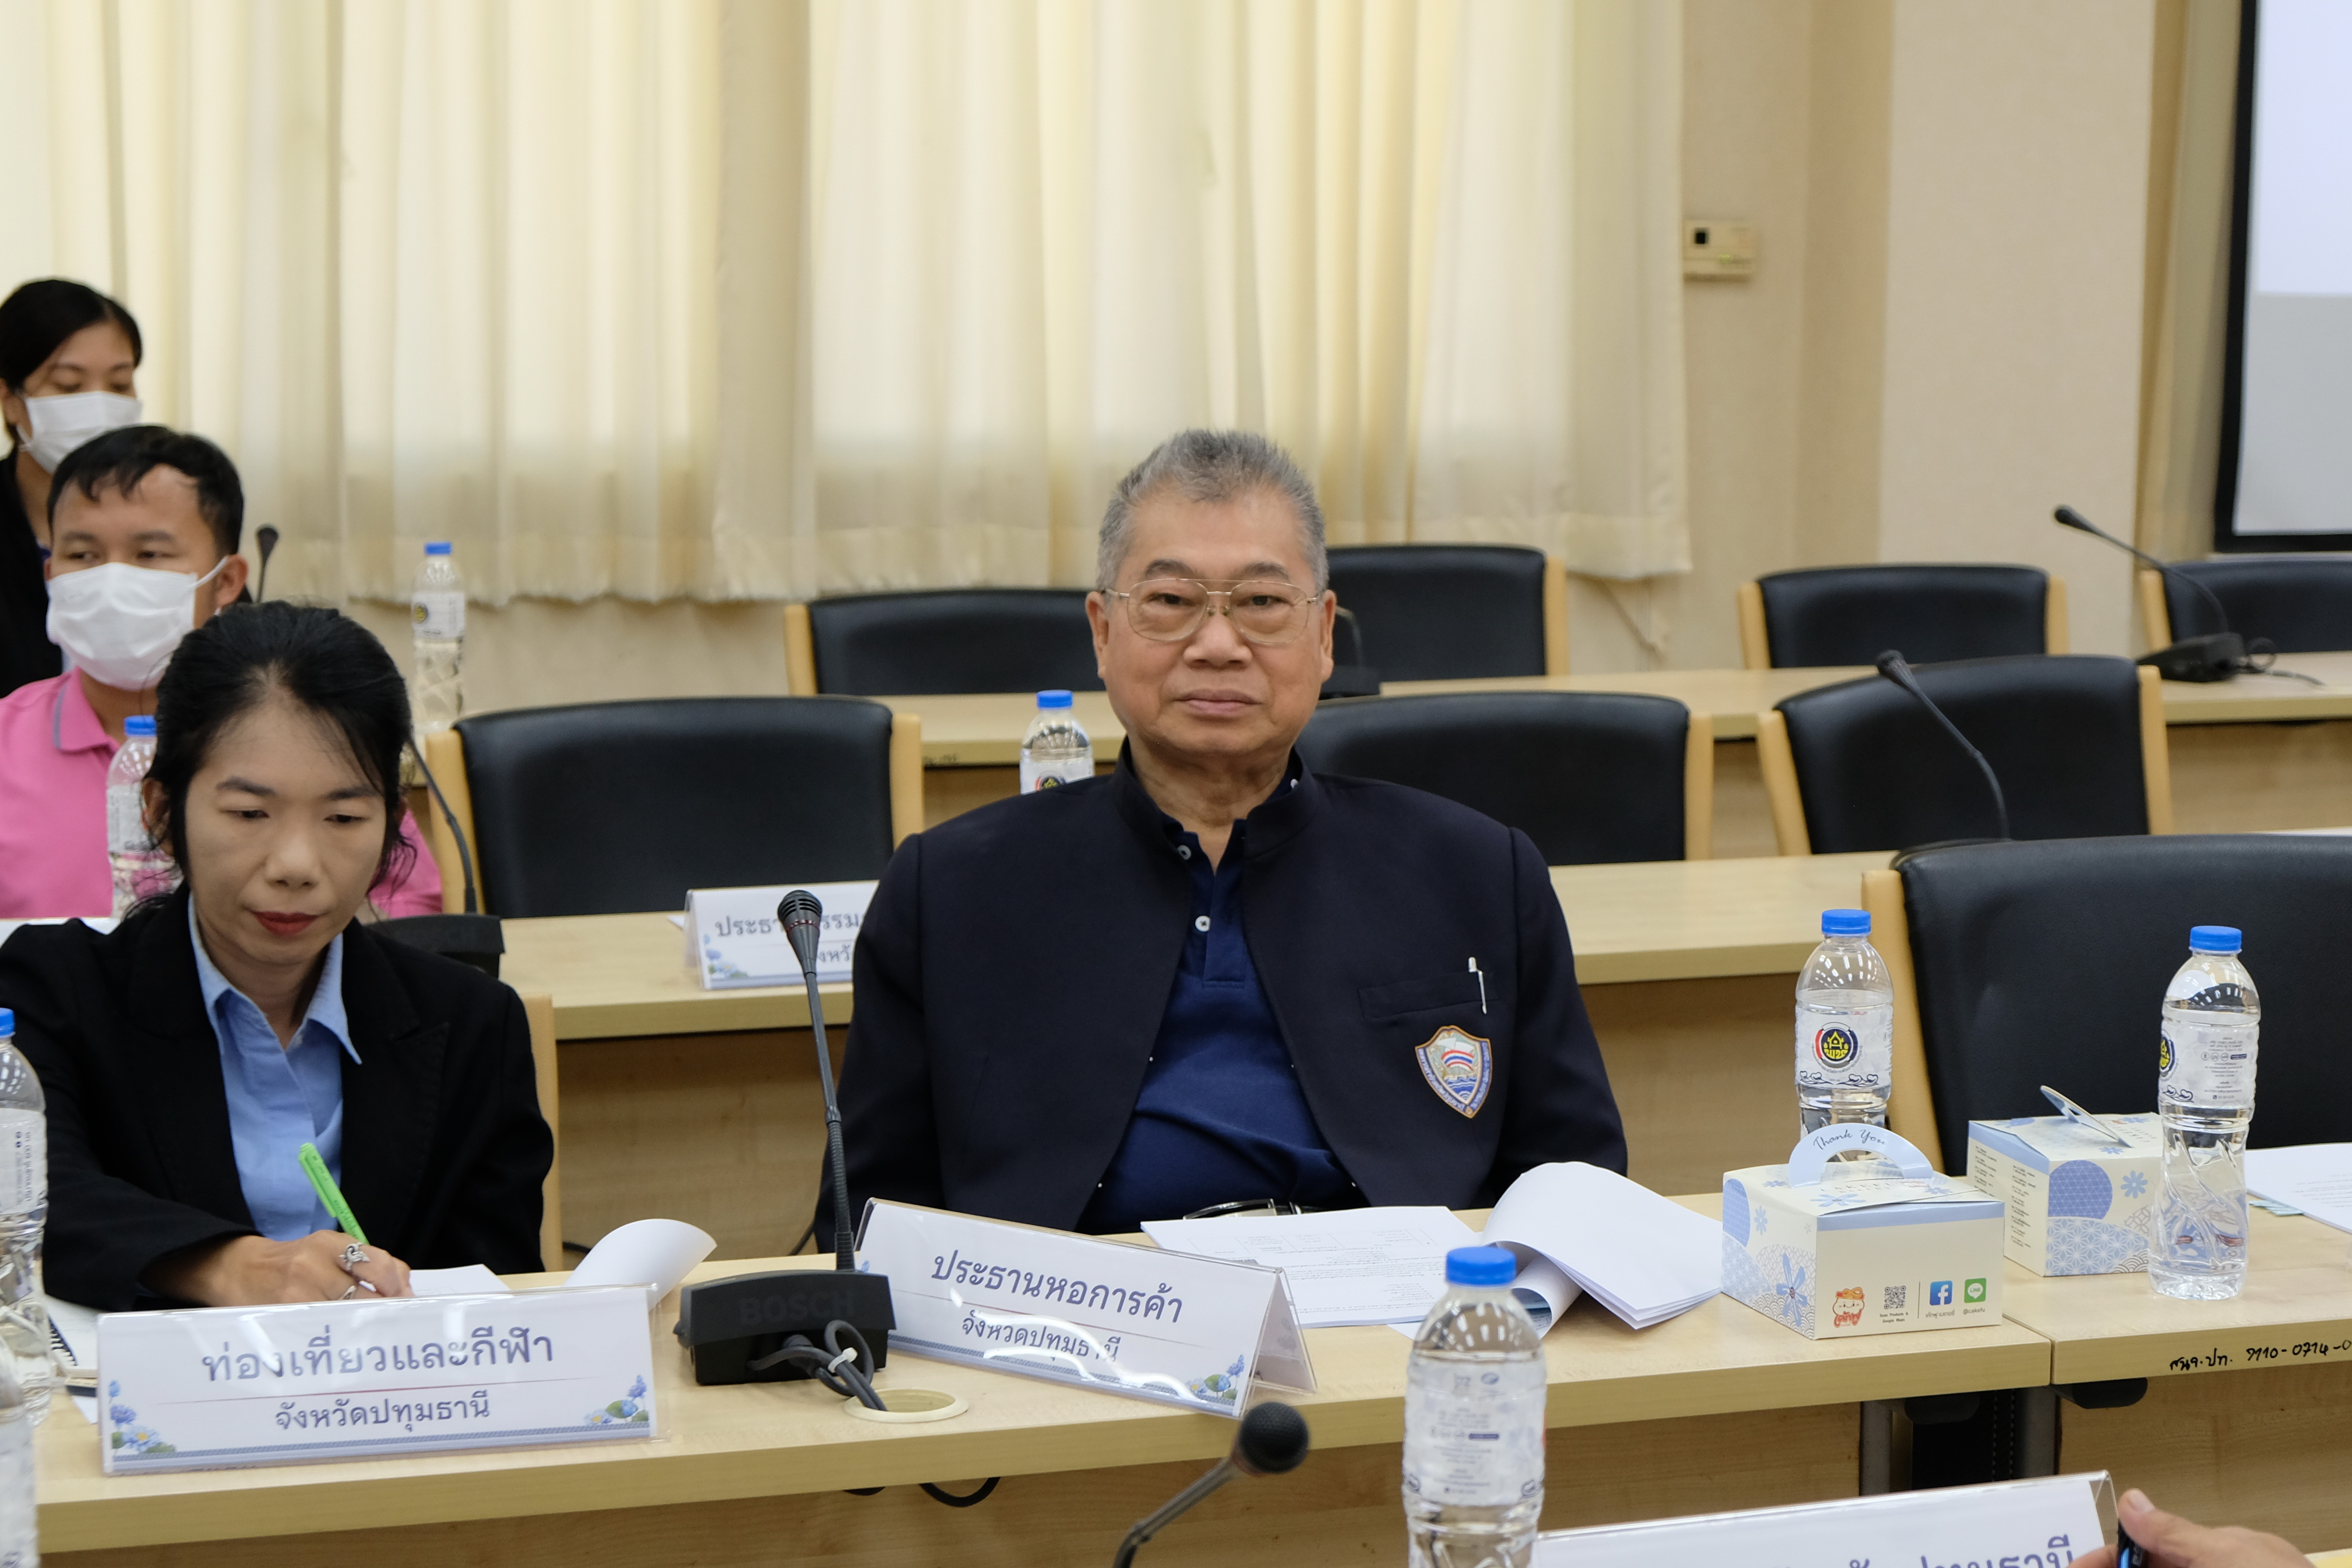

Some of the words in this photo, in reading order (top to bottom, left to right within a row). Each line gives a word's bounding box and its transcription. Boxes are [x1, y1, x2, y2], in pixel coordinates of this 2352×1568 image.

[1813, 1129, 1853, 1150] Thank
[1860, 1129, 1886, 1144] You
[931, 1249, 1183, 1323] ประธานหอการค้า
[740, 1290, 856, 1325] BOSCH
[1963, 1307, 1985, 1315] @cakefu
[202, 1324, 554, 1381] ท่องเที่ยวและกีฬา
[962, 1308, 1122, 1361] จังหวดปทุมธนี
[275, 1390, 490, 1432] จังหวัดปทุมธานี
